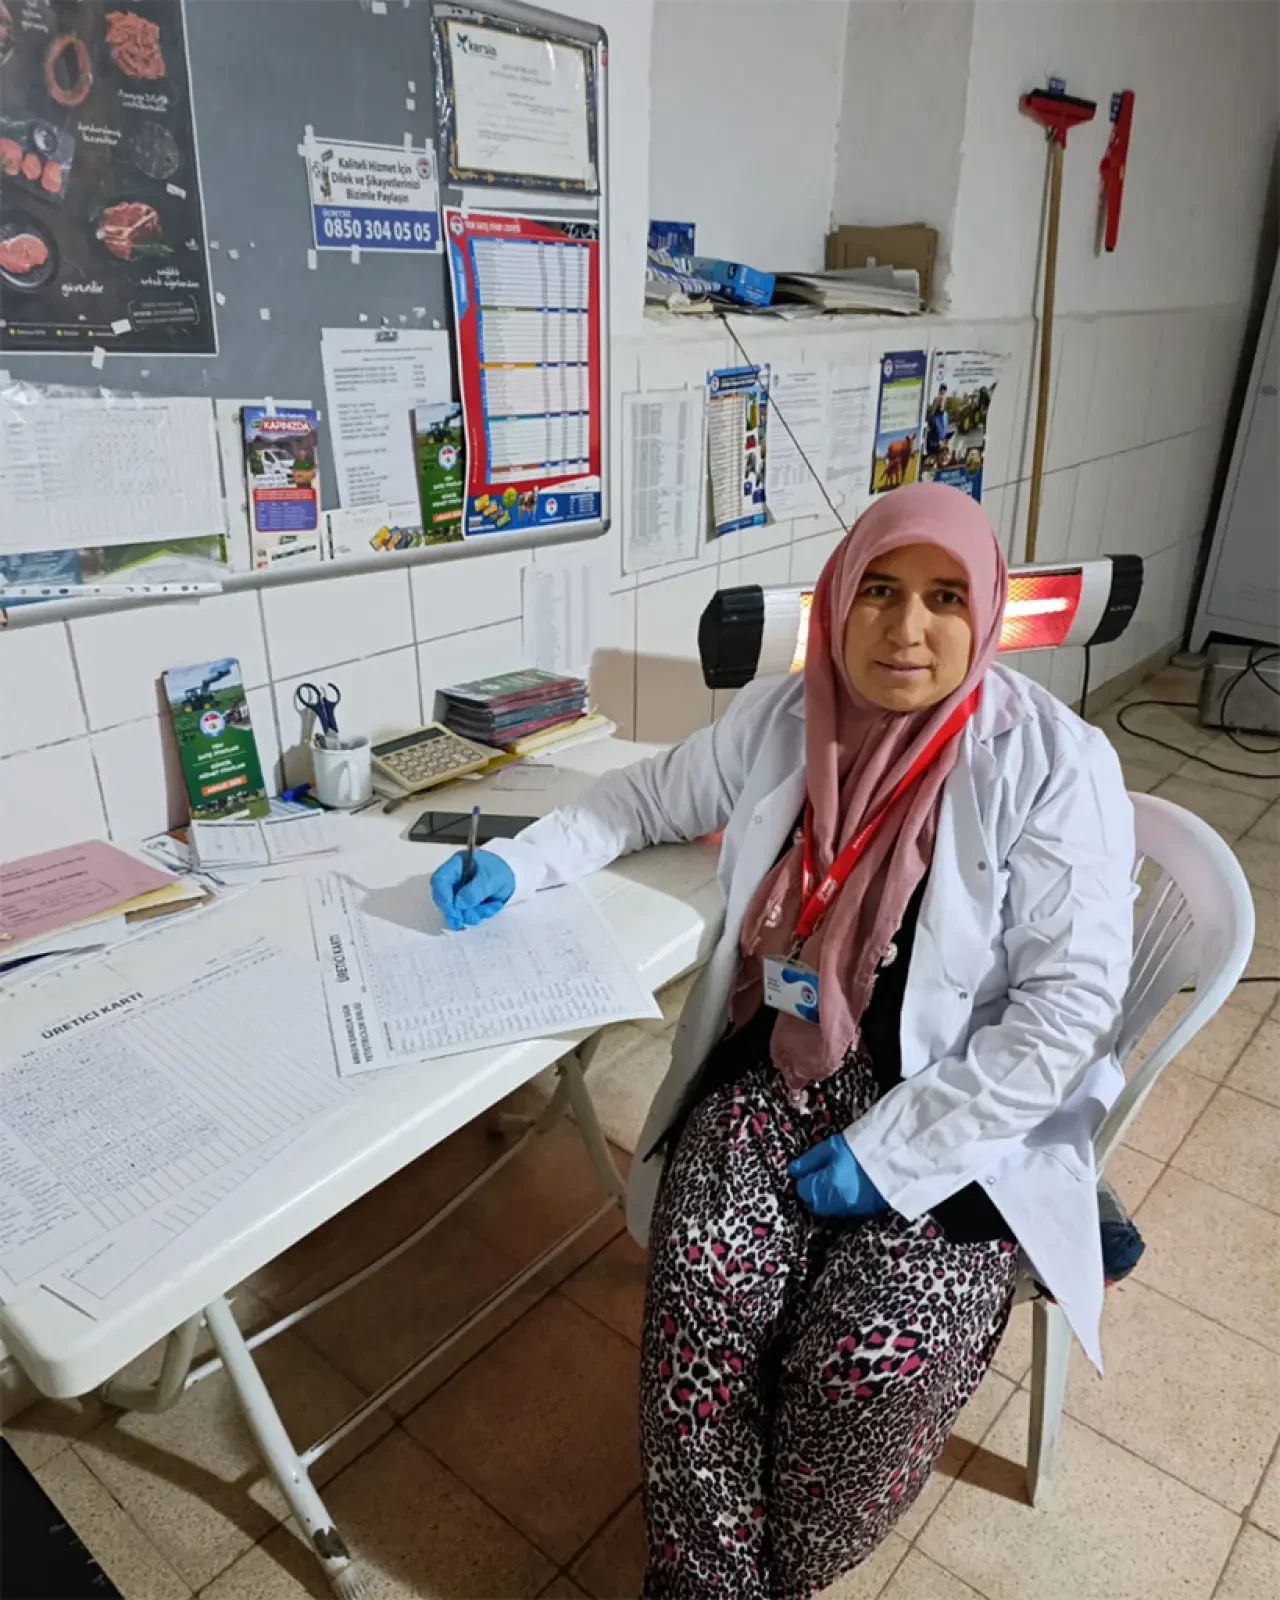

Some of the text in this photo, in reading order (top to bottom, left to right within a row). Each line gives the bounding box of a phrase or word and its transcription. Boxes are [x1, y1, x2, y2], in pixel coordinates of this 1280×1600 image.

[338, 157, 412, 175] Kaliteli Hizmet İçin
[331, 172, 353, 184] Dilek
[355, 176, 365, 186] ve
[346, 189, 410, 204] Bizimle Paylaşın
[324, 218, 432, 242] 0850 304 05 05
[41, 991, 144, 1040] ÜRETİCİ KARTI
